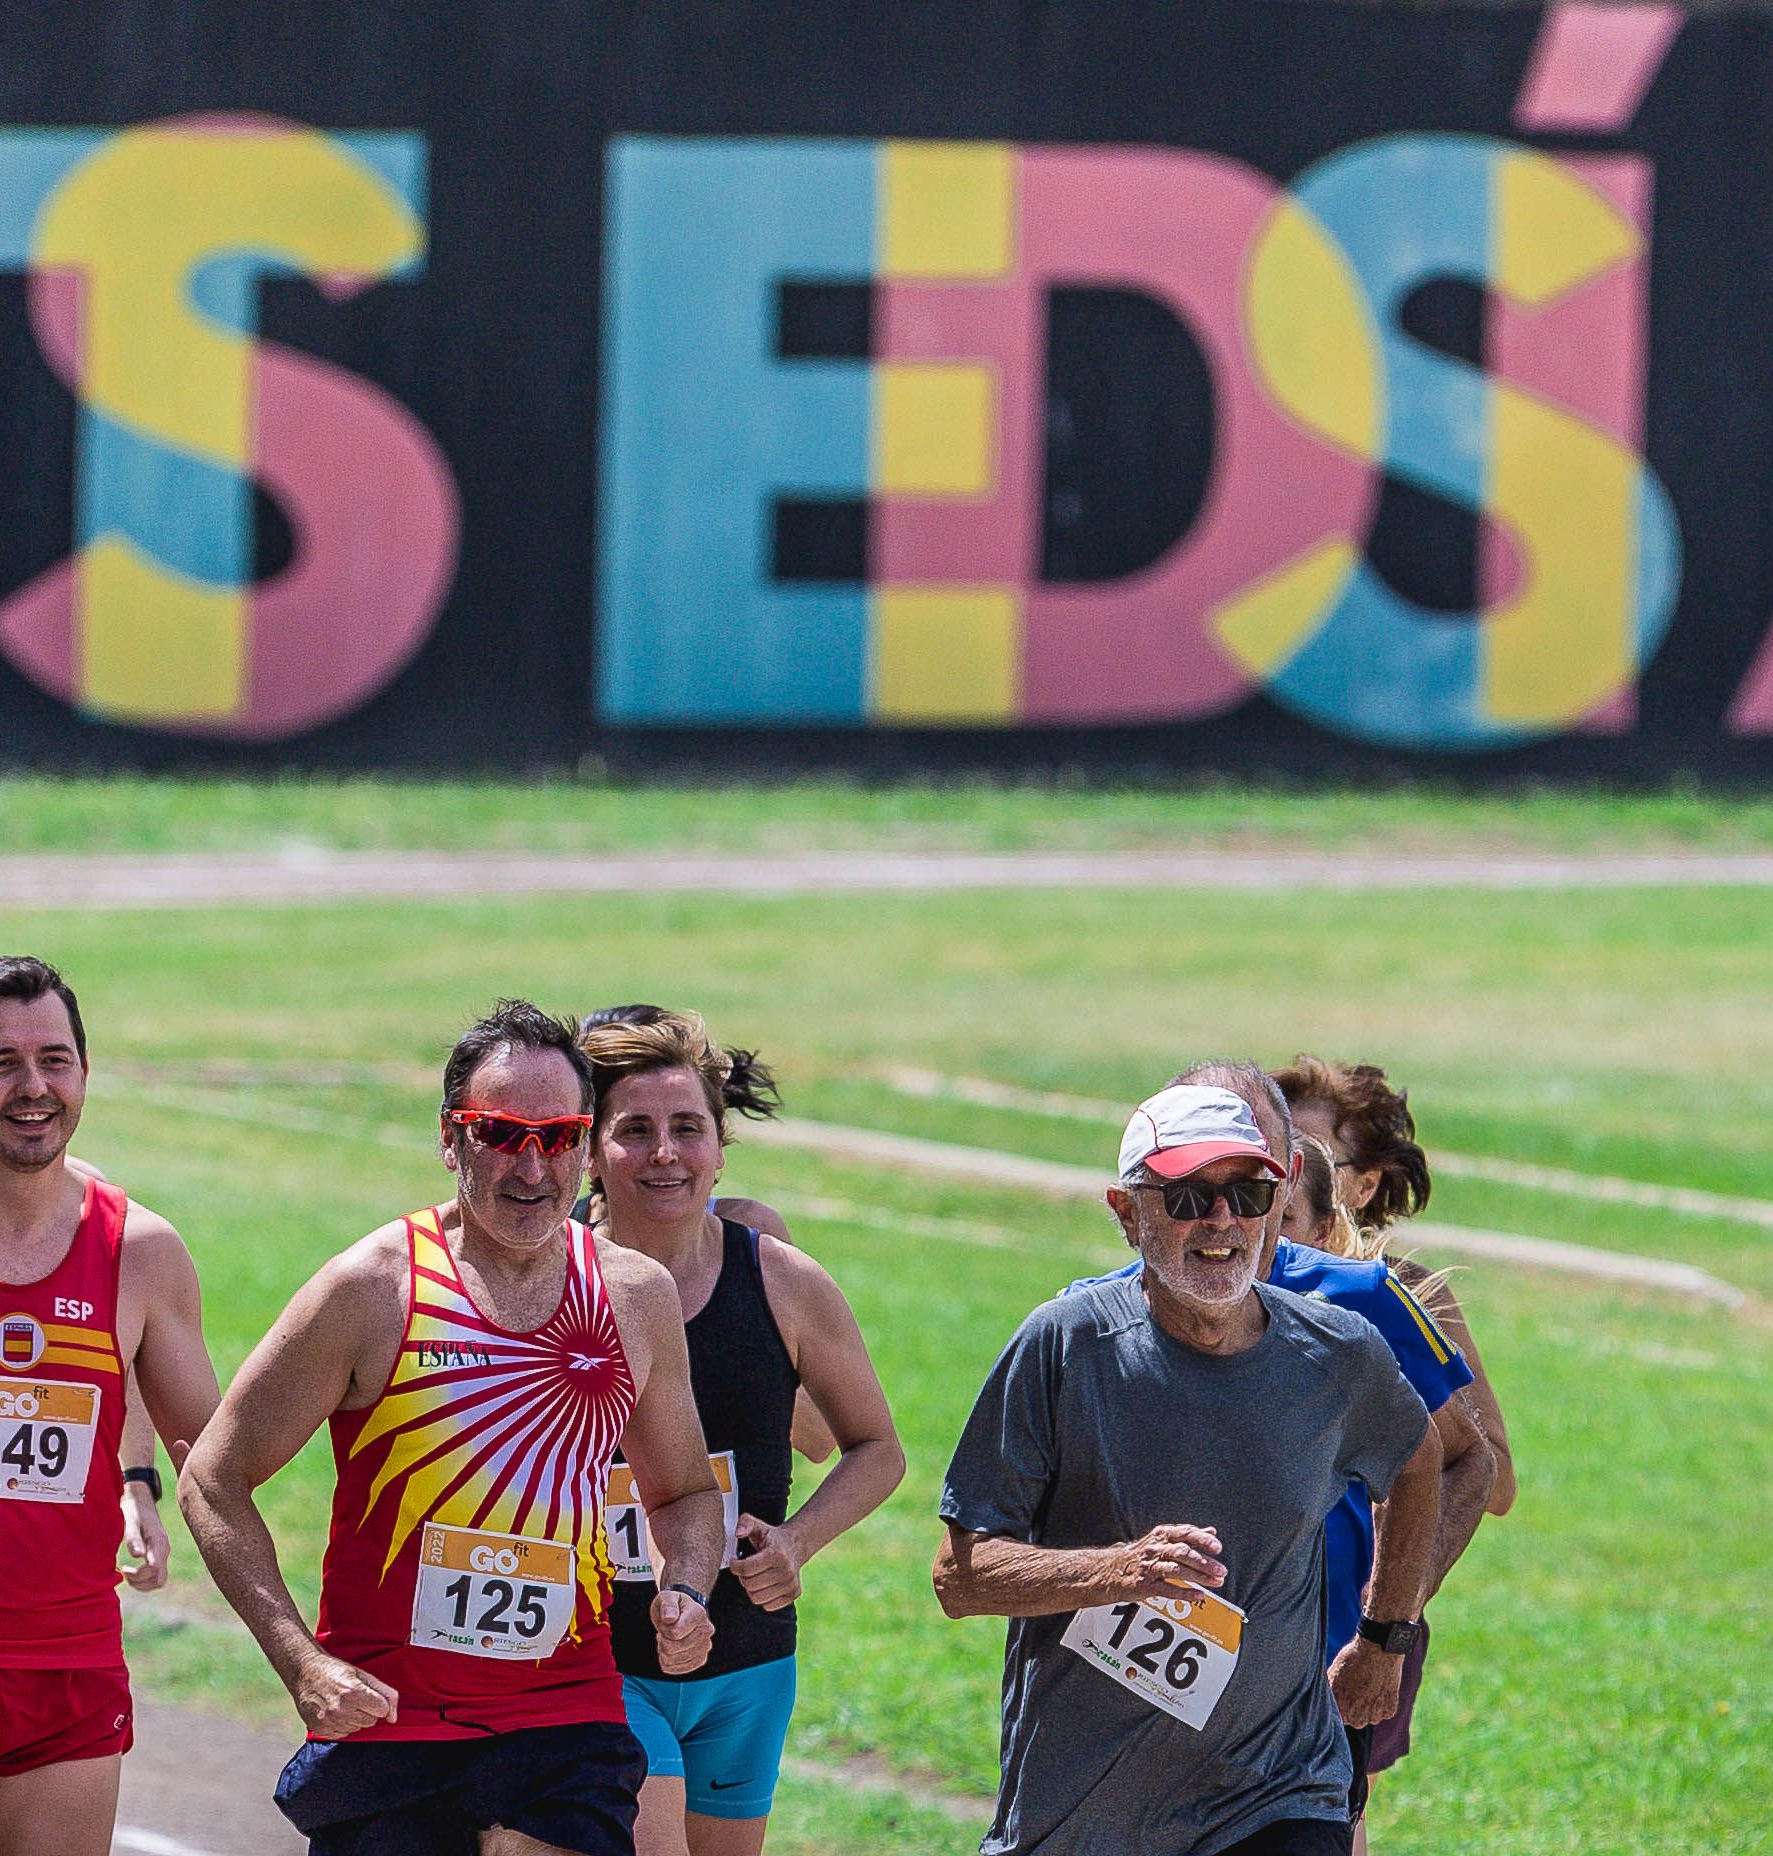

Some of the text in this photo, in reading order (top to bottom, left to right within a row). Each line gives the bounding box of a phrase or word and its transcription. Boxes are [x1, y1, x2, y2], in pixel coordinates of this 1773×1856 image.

[54, 1296, 94, 1321] ESP
[419, 1340, 491, 1368] ESPAÑA
[33, 1385, 50, 1400] fit
[431, 1531, 445, 1564] 2022
[469, 1541, 530, 1575] GO fit
[445, 1574, 548, 1639] 125
[1108, 1602, 1209, 1691] 126
